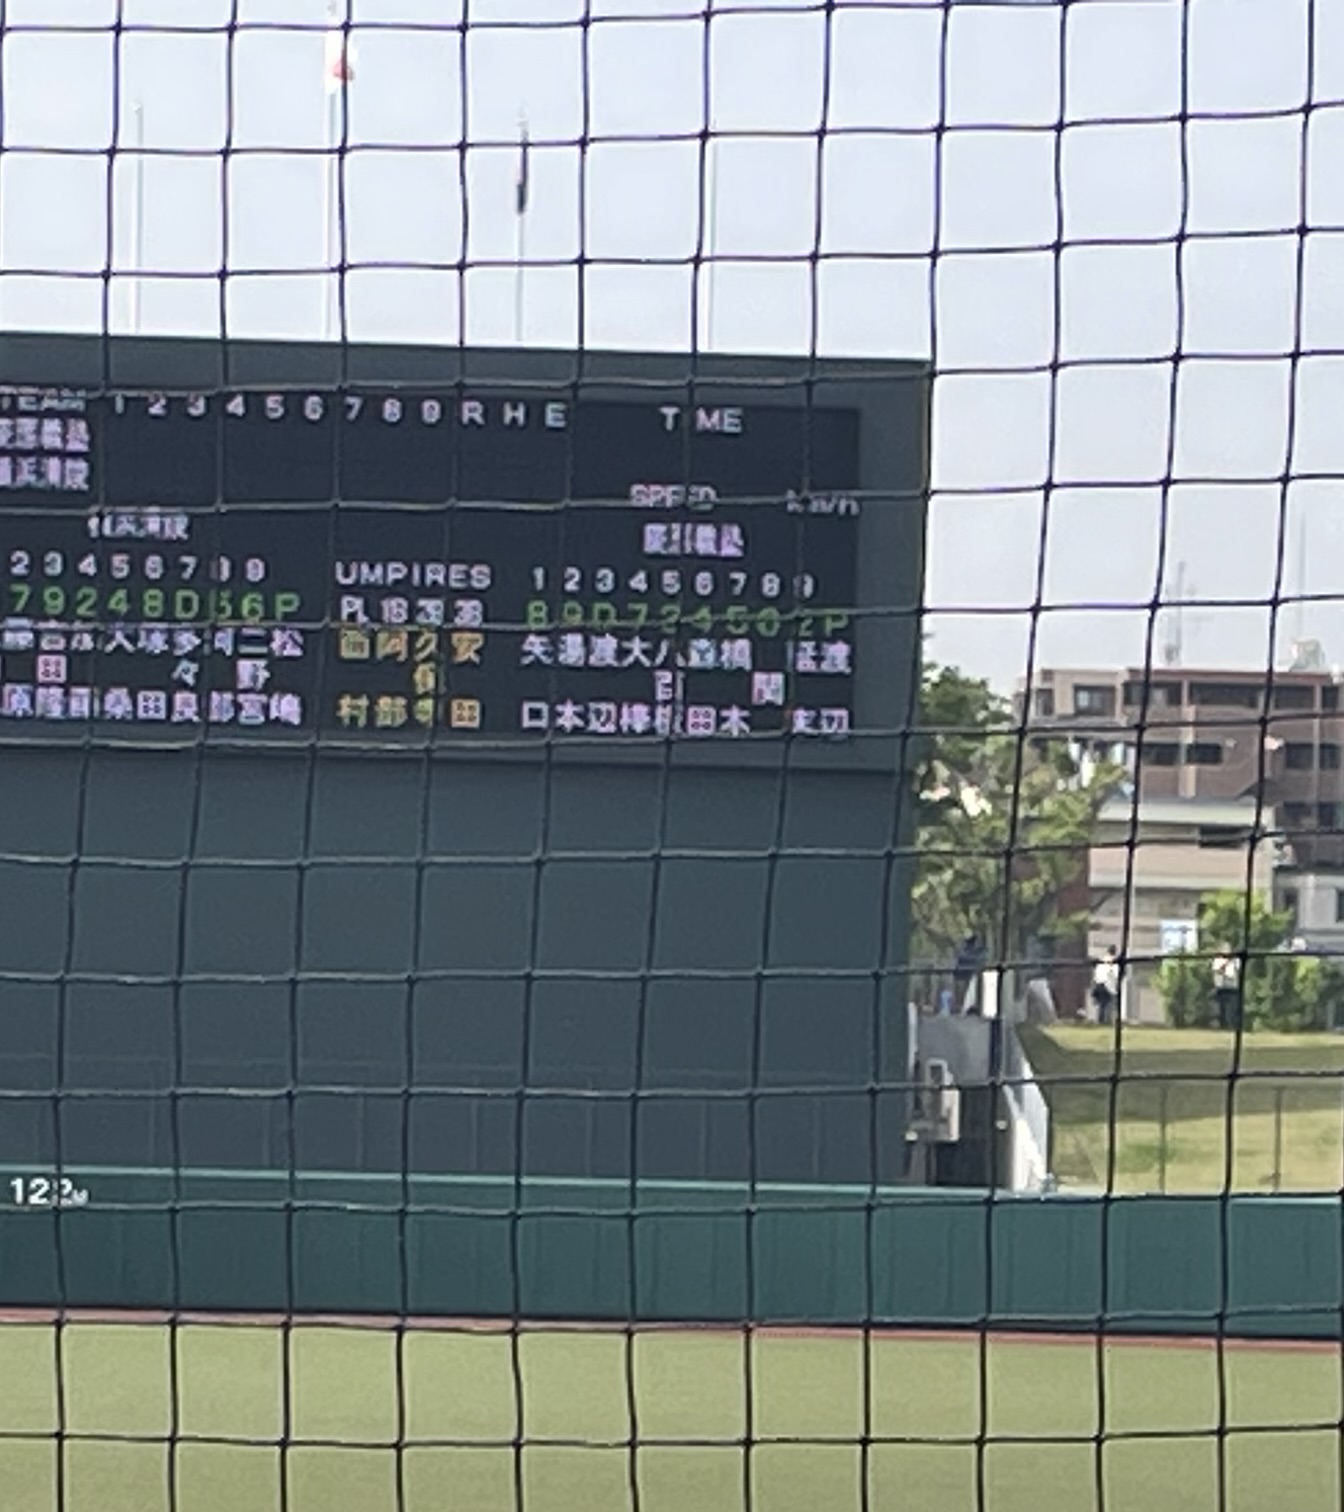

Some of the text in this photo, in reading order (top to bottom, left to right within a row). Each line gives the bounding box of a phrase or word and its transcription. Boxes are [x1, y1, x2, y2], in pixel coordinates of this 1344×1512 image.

[113, 394, 124, 414] 1
[148, 394, 167, 416] 2
[187, 394, 206, 417] 3
[226, 394, 246, 417] 4
[265, 396, 285, 419] 5
[304, 396, 324, 421] 6
[344, 397, 363, 420] 7
[382, 399, 403, 422] 8
[421, 401, 442, 424] 9
[461, 401, 485, 426] R
[503, 403, 525, 428] H
[544, 404, 568, 429] E
[659, 406, 742, 433] TME
[10, 550, 30, 577] 2
[43, 551, 64, 577] 3
[77, 553, 98, 577] 4
[111, 554, 130, 579] 5
[179, 556, 198, 580] 7
[335, 561, 492, 590] UMPIRES
[533, 567, 545, 592] 1
[563, 567, 582, 593] 2
[596, 568, 616, 593] 3
[628, 569, 649, 593] 4
[662, 570, 682, 595] 5
[695, 571, 715, 597] 6
[729, 572, 748, 596] 7
[761, 572, 781, 598] 8
[10, 583, 32, 613] 7
[43, 585, 66, 616] 9
[76, 586, 98, 617] 2
[107, 588, 130, 617] 4
[143, 588, 165, 619] 8
[175, 589, 199, 619] D
[241, 592, 265, 622] 6
[275, 592, 301, 622] P
[527, 600, 549, 630] 8
